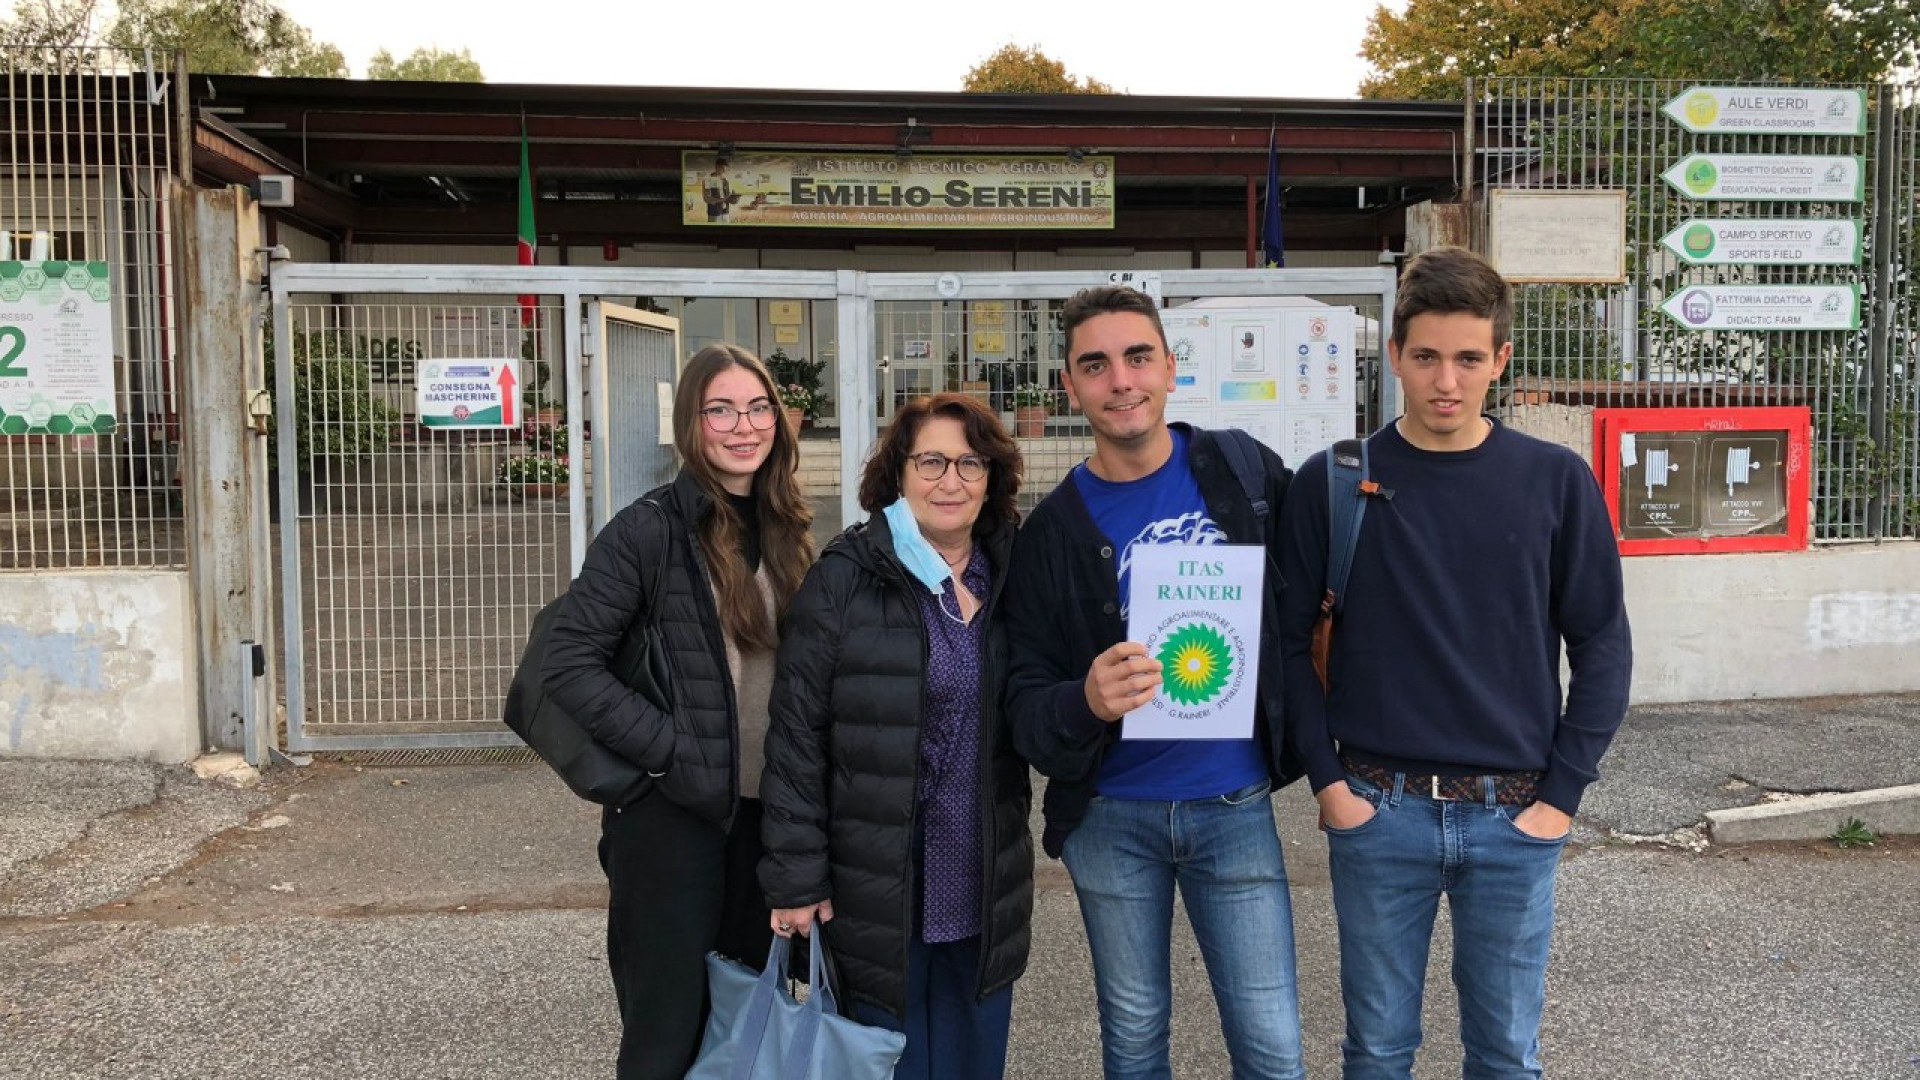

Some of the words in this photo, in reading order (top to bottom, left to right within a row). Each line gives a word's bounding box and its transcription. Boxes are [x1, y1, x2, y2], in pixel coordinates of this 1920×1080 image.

[1728, 97, 1763, 109] AULE
[1767, 98, 1808, 109] VERDI
[1720, 119, 1751, 127] GREEN
[1754, 119, 1816, 127] CLASSROOMS
[816, 160, 898, 173] ISTITUTO
[908, 161, 987, 174] TECNICO
[997, 162, 1079, 174] AGRARIO
[1721, 166, 1770, 174] BOSCHETTO
[1771, 167, 1813, 175] DIDATTICO
[791, 178, 931, 207] EMILIO
[1721, 186, 1778, 194] EDUCATIONAL
[1719, 231, 1757, 239] CAMPO
[1760, 231, 1812, 239] SPORTIVO
[1728, 250, 1770, 259] SPORTS
[1773, 250, 1802, 259] FIELD
[1715, 296, 1761, 304] FATTORIA
[1764, 296, 1812, 304] DIDATTICA
[1727, 316, 1772, 325] DIDACTIC
[1775, 316, 1802, 325] FARM
[0, 326, 28, 377] 2
[430, 383, 491, 392] CONSEGNA
[425, 393, 498, 402] MASCHERINE
[1178, 560, 1224, 577] ITAS
[1157, 584, 1242, 601] RAINERI
[1157, 610, 1230, 633] AGROALIMENTARE
